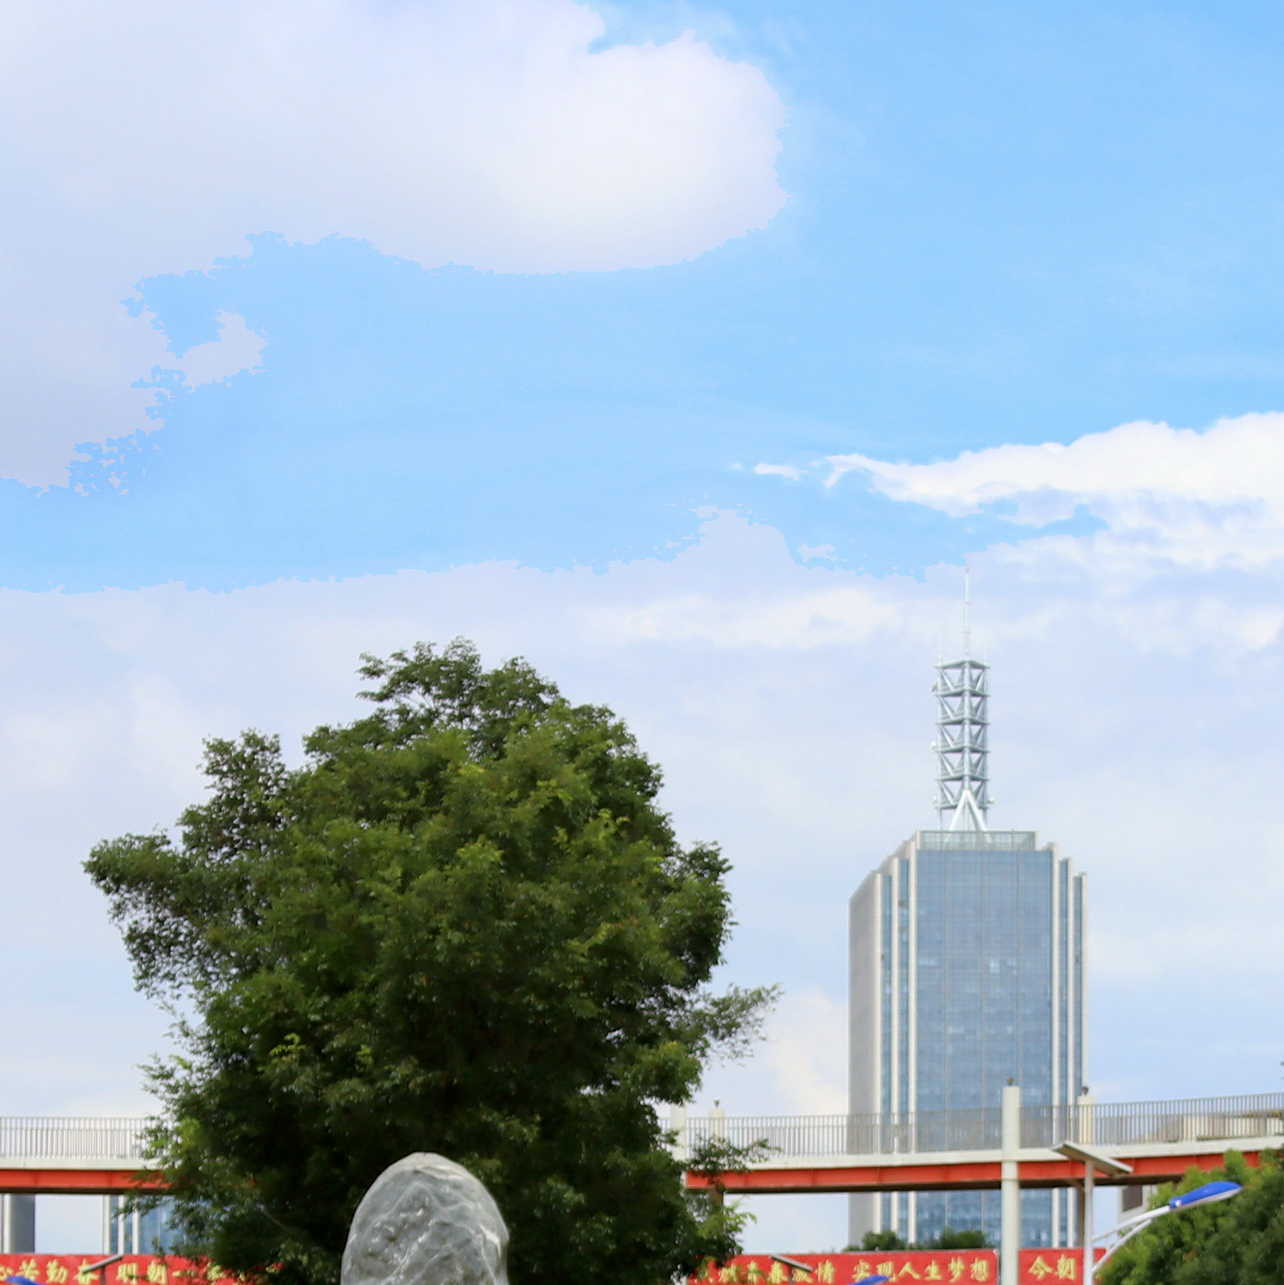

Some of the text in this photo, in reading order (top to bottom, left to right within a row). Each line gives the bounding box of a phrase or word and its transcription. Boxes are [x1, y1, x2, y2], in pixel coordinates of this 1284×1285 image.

[694, 1256, 990, 1285] 燃青春激情 实现人生梦想
